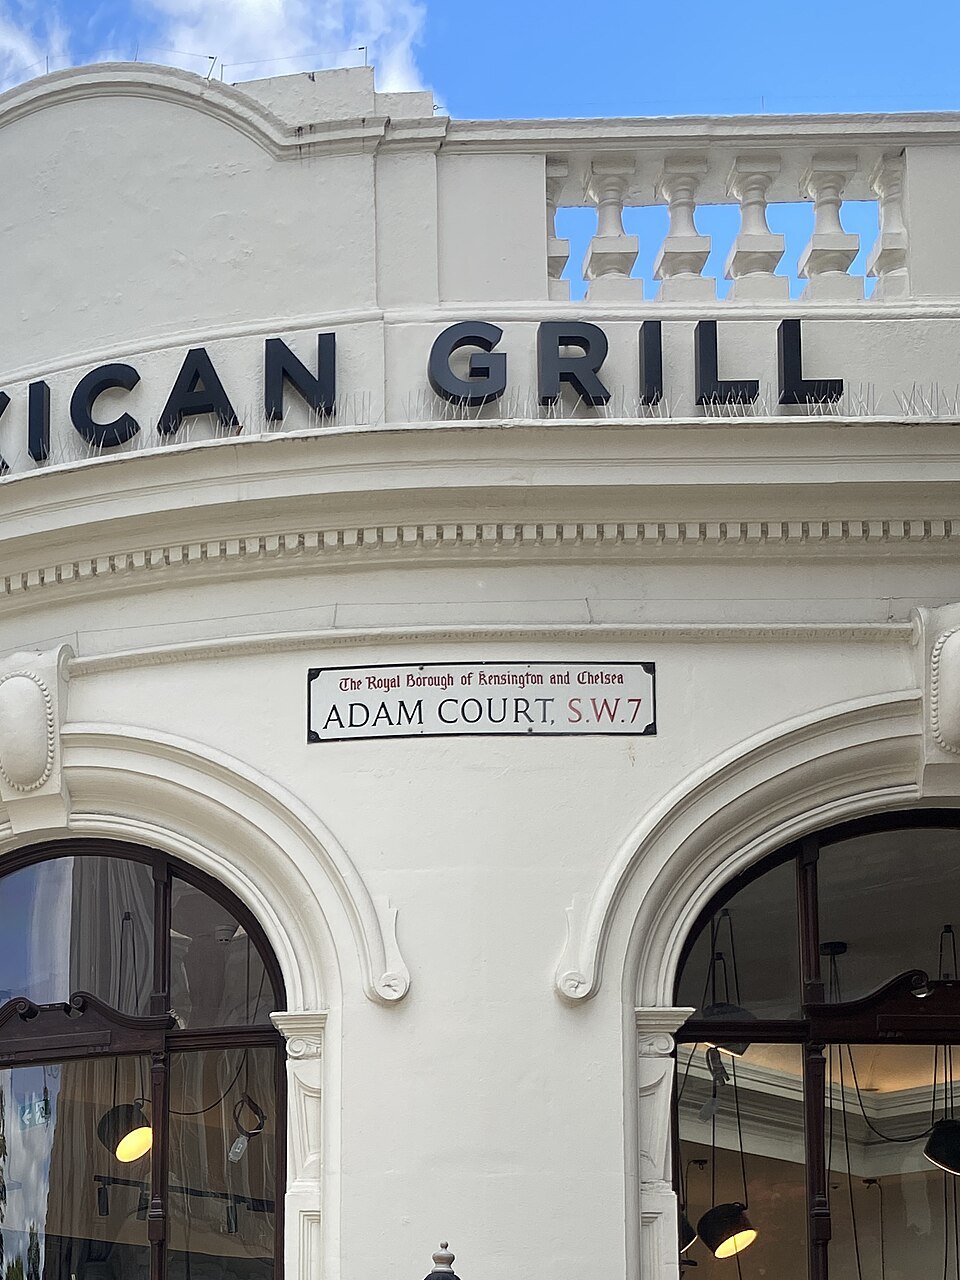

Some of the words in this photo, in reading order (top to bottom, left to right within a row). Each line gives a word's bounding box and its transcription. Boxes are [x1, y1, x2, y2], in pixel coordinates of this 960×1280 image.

[427, 319, 844, 407] GRILL
[339, 677, 362, 692] The
[366, 675, 400, 693] Royal
[406, 673, 454, 690] Borough
[460, 672, 474, 687] of
[479, 671, 544, 689] Kensington
[550, 671, 570, 687] and
[577, 671, 624, 686] Chelsea
[323, 699, 424, 730] ADAM
[437, 698, 555, 726] COURT,
[567, 698, 642, 725] S.W.7
